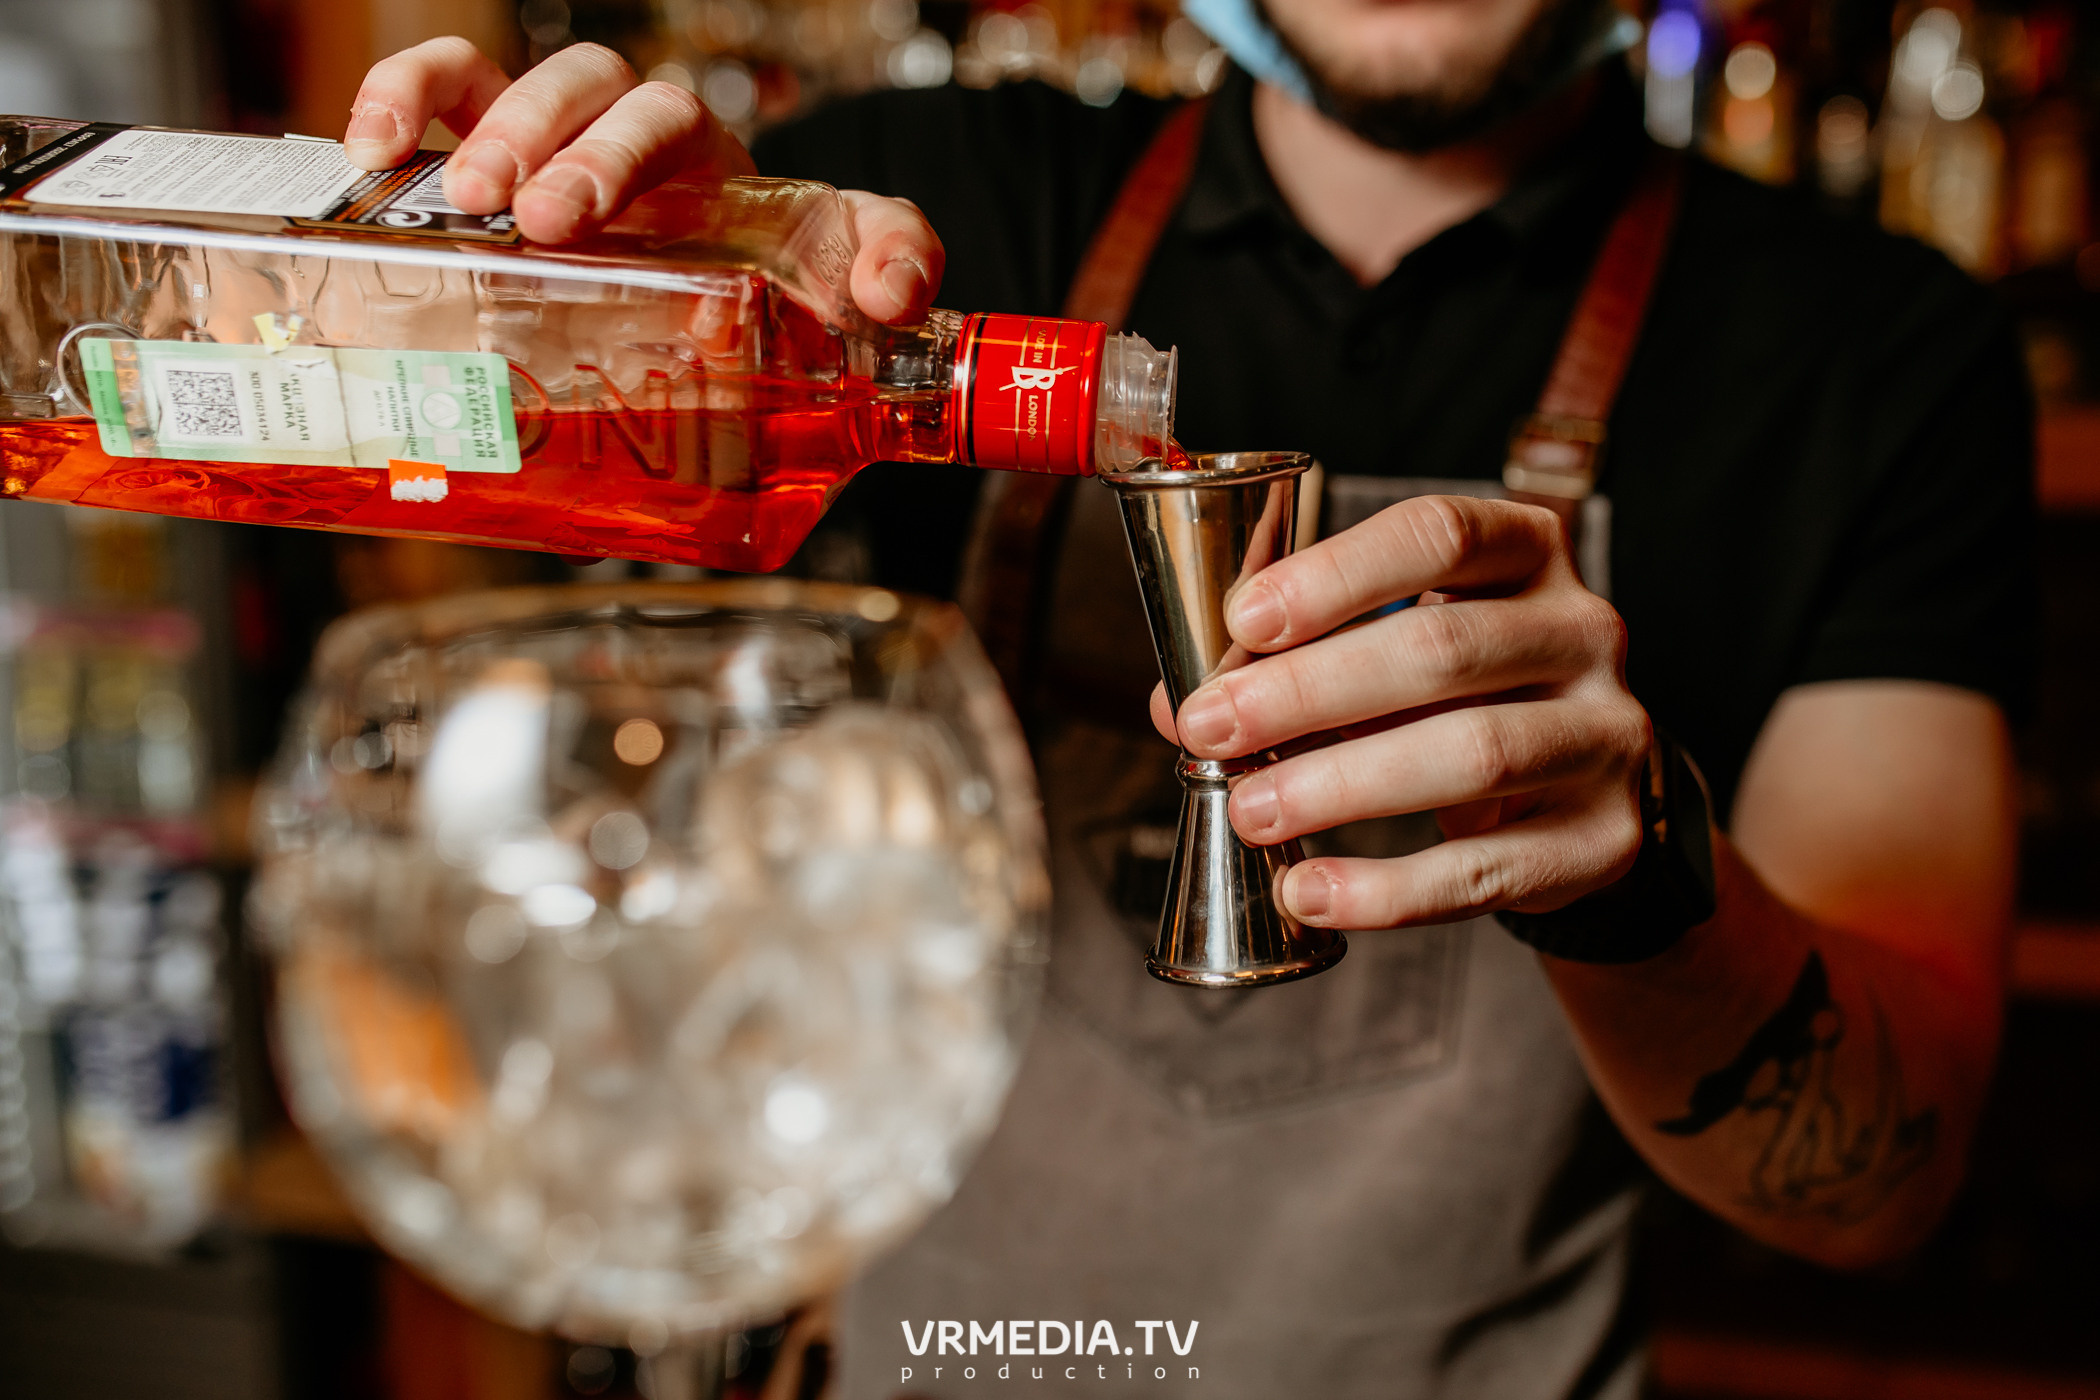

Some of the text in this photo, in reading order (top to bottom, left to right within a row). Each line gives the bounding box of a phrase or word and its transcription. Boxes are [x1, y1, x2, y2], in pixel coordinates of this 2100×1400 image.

[1033, 351, 1044, 363] IN
[279, 382, 297, 428] МАРКА
[289, 373, 310, 441] КЦЗНАЯ
[463, 366, 487, 459] ФЕДЕРАЦИЯ
[475, 366, 499, 458] РОССИЙСКАЯ
